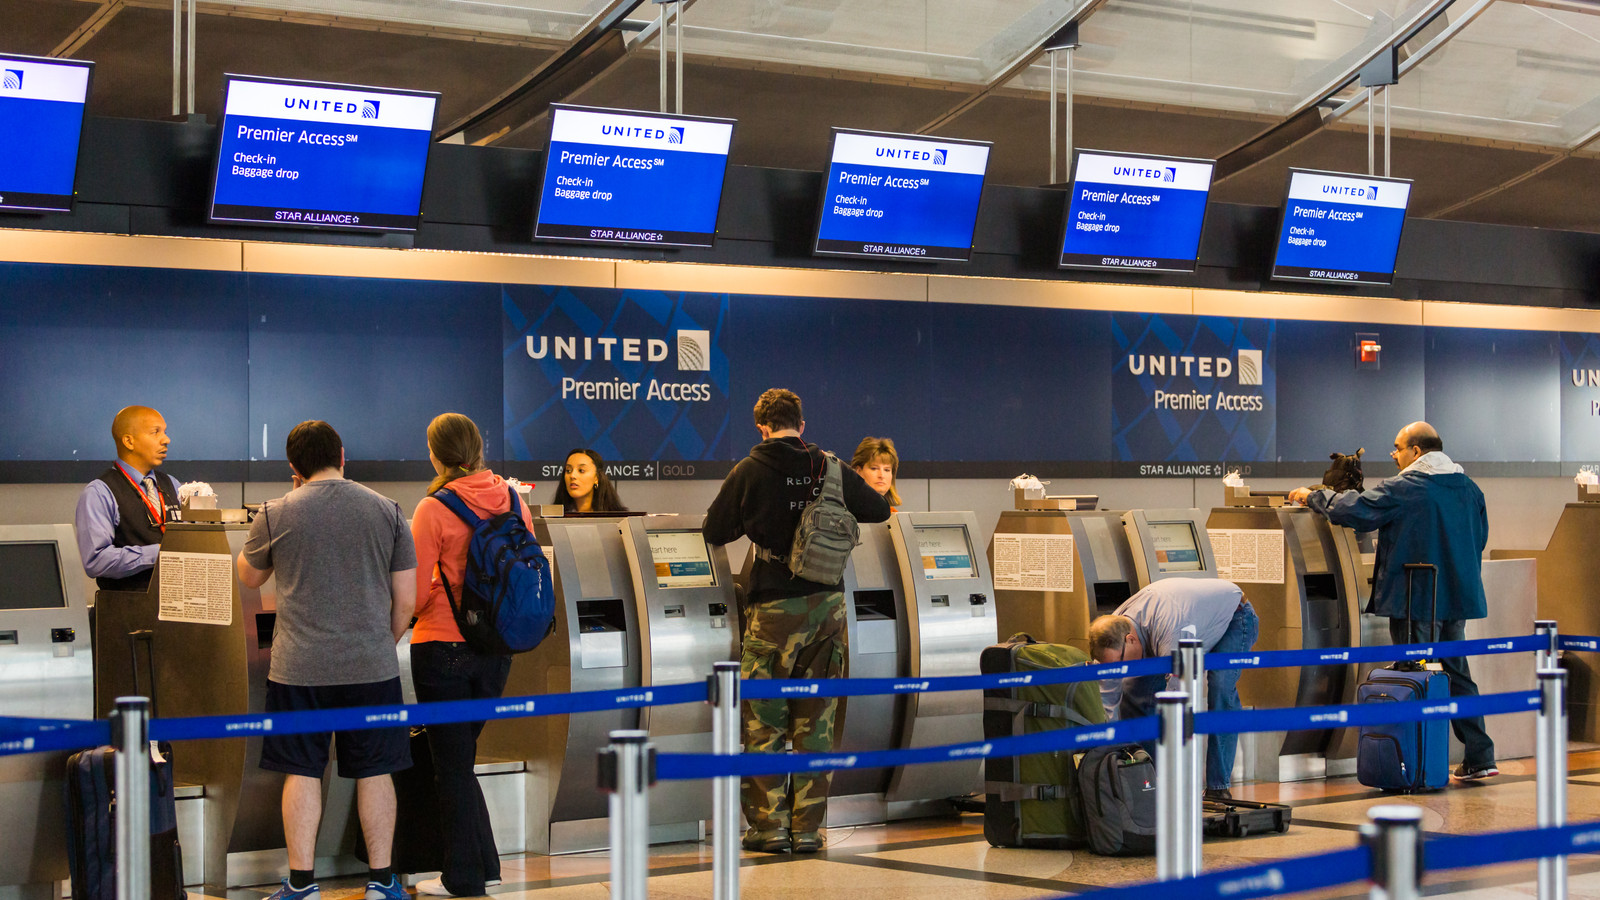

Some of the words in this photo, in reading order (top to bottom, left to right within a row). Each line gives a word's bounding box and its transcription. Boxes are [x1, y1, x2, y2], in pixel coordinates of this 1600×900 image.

[284, 98, 358, 114] UNITED
[238, 125, 295, 142] Premier
[602, 125, 664, 139] UNITED
[234, 152, 276, 164] Check-in
[561, 151, 610, 166] Premier
[876, 148, 930, 160] UNITED
[232, 165, 273, 178] Baggage
[276, 168, 299, 180] drop
[1114, 167, 1161, 178] UNITED
[556, 176, 593, 187] Check-in
[840, 172, 882, 186] Premier
[555, 188, 590, 199] Baggage
[592, 190, 612, 201] drop
[1082, 189, 1119, 203] Premier
[1323, 185, 1365, 197] UNITED
[836, 194, 867, 206] Check-in
[275, 211, 301, 220] STAR
[304, 213, 352, 224] ALLIANCE
[833, 206, 864, 217] Baggage
[866, 208, 884, 218] drop
[1078, 211, 1106, 221] Check-in
[1294, 206, 1327, 218] Premier
[1076, 222, 1103, 232] Baggage
[1104, 223, 1120, 233] drop
[1290, 226, 1315, 236] Check-in
[590, 229, 613, 238] STAR
[615, 231, 656, 240] ALLIANCE
[1288, 236, 1312, 246] Baggage
[1313, 237, 1326, 247] drop
[863, 245, 883, 253] STAR
[884, 246, 920, 255] ALLIANCE
[1120, 259, 1151, 267] ALLIANCE
[1326, 271, 1354, 280] ALLIANCE
[526, 336, 668, 362] UNITED
[1128, 354, 1233, 378] UNITED
[562, 377, 641, 400] Premier
[646, 378, 710, 402] Access
[1154, 390, 1212, 410] Premier
[1216, 391, 1263, 411] Access
[542, 466, 565, 477] STA
[605, 465, 640, 476] ANCE
[662, 465, 695, 476] GOLD
[1140, 465, 1164, 475] STAR
[1166, 465, 1211, 475] ALLIANCE
[786, 476, 811, 485] RED
[365, 713, 399, 722] UNITED
[226, 721, 262, 730] UNITED
